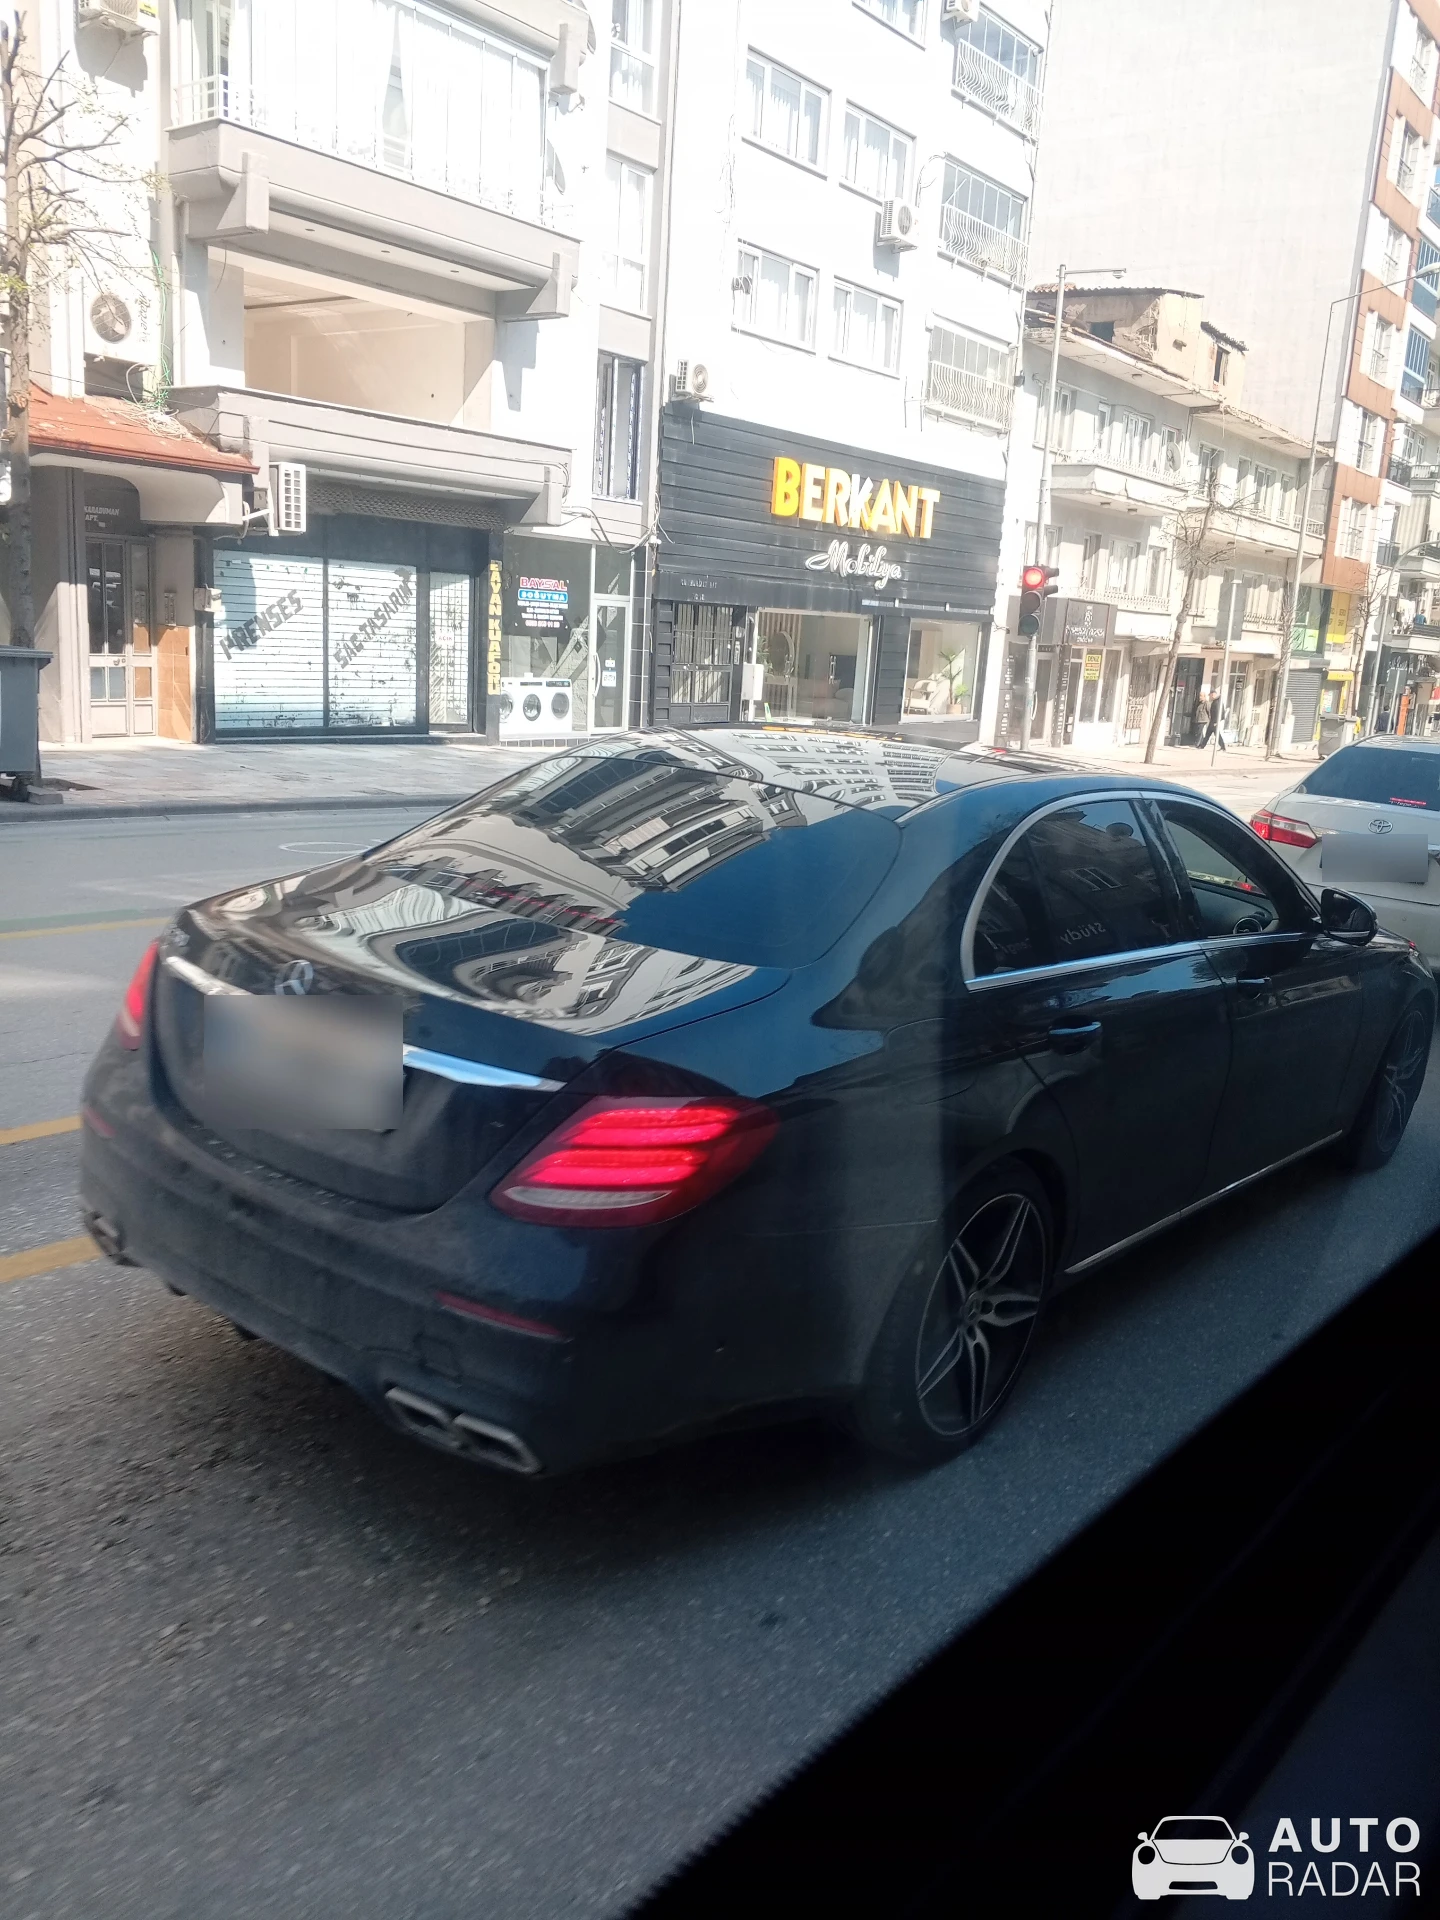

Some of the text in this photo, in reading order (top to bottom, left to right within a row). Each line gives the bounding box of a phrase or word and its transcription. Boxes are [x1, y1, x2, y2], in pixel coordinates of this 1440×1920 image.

[771, 456, 941, 539] BERKANT
[520, 577, 567, 591] BAYSAL
[805, 539, 902, 590] Mobilya
[219, 589, 303, 661] PRENSES
